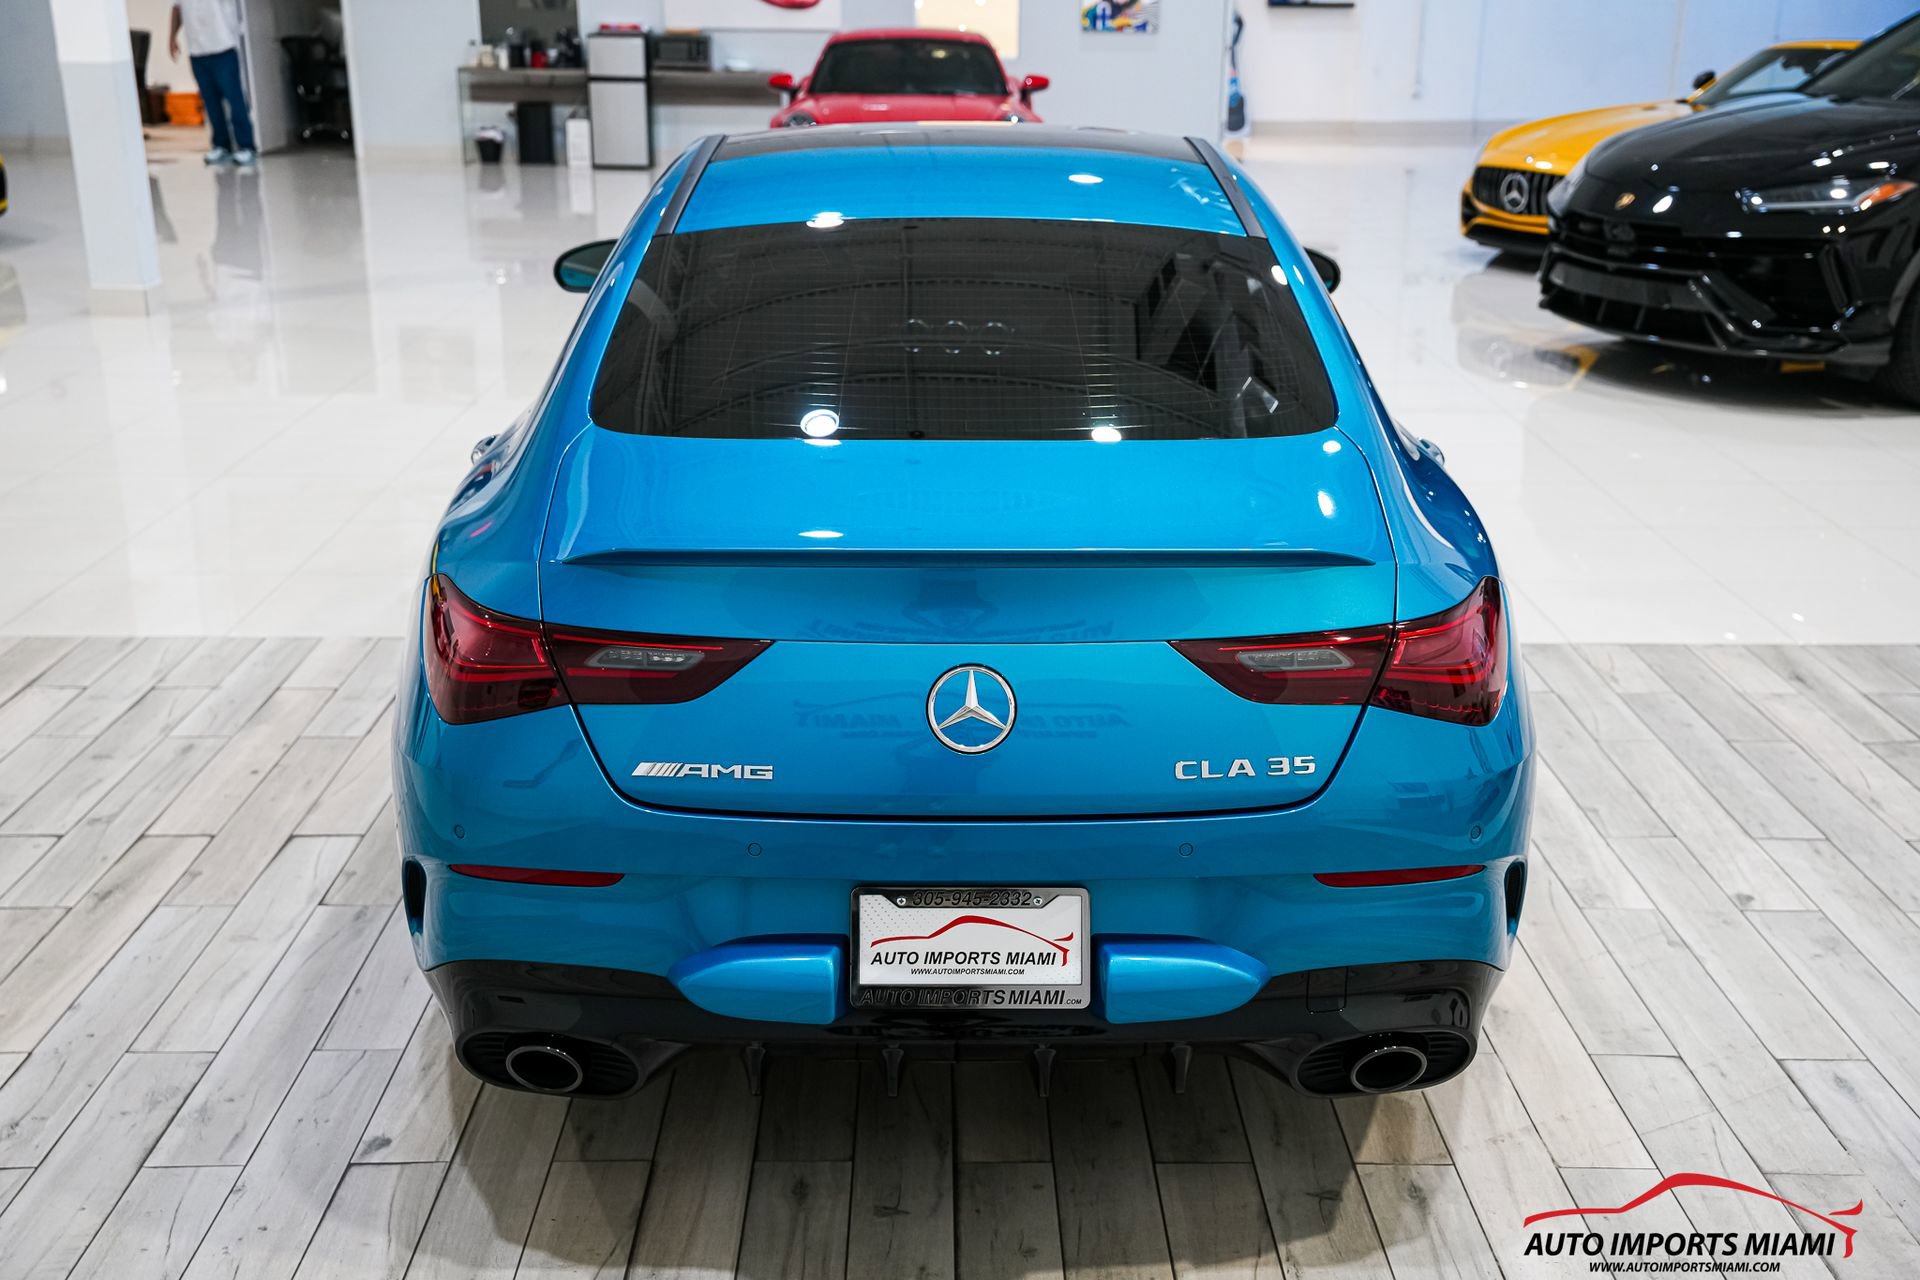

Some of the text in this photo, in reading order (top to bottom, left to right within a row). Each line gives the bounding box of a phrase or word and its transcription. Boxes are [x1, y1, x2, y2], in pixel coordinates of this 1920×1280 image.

[1174, 755, 1316, 780] CLA 35
[912, 890, 1033, 906] 305-945-2332
[870, 951, 1056, 966] AUTO IMPORTS MIAMI
[861, 988, 916, 1005] AUTO
[917, 988, 1006, 1006] IMPORTS
